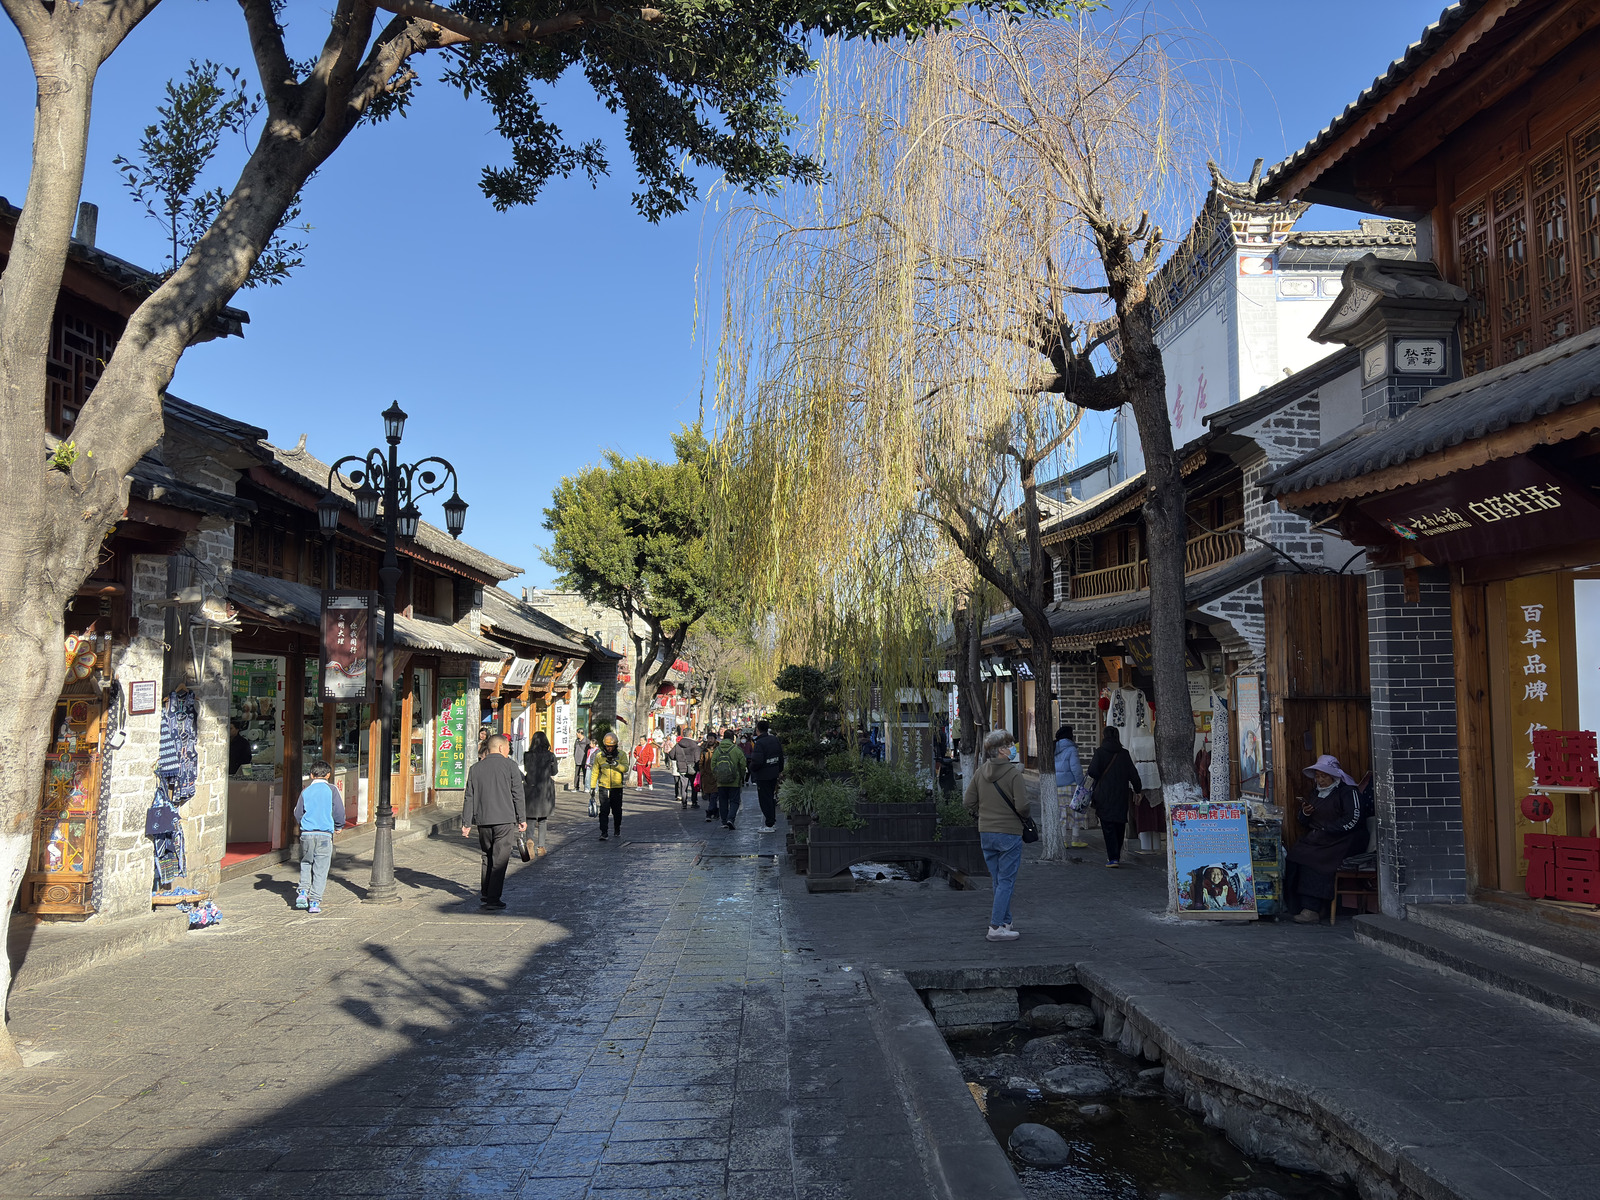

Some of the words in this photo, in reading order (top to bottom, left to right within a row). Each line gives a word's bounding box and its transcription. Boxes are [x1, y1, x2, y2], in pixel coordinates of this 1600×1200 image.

[1409, 507, 1464, 530] 云南白药
[1468, 483, 1561, 523] 白药生活+
[1444, 520, 1473, 533] BAIYAO
[337, 614, 346, 645] 文明大理
[349, 622, 358, 654] 你我同行
[1520, 603, 1549, 703] 百年品牌
[439, 698, 453, 752] 翡翠玉石
[455, 681, 466, 732] 手镯60元一支
[439, 751, 450, 787] 工厂直销
[453, 735, 465, 786] 挂件50元一件
[1524, 832, 1600, 905] 福
